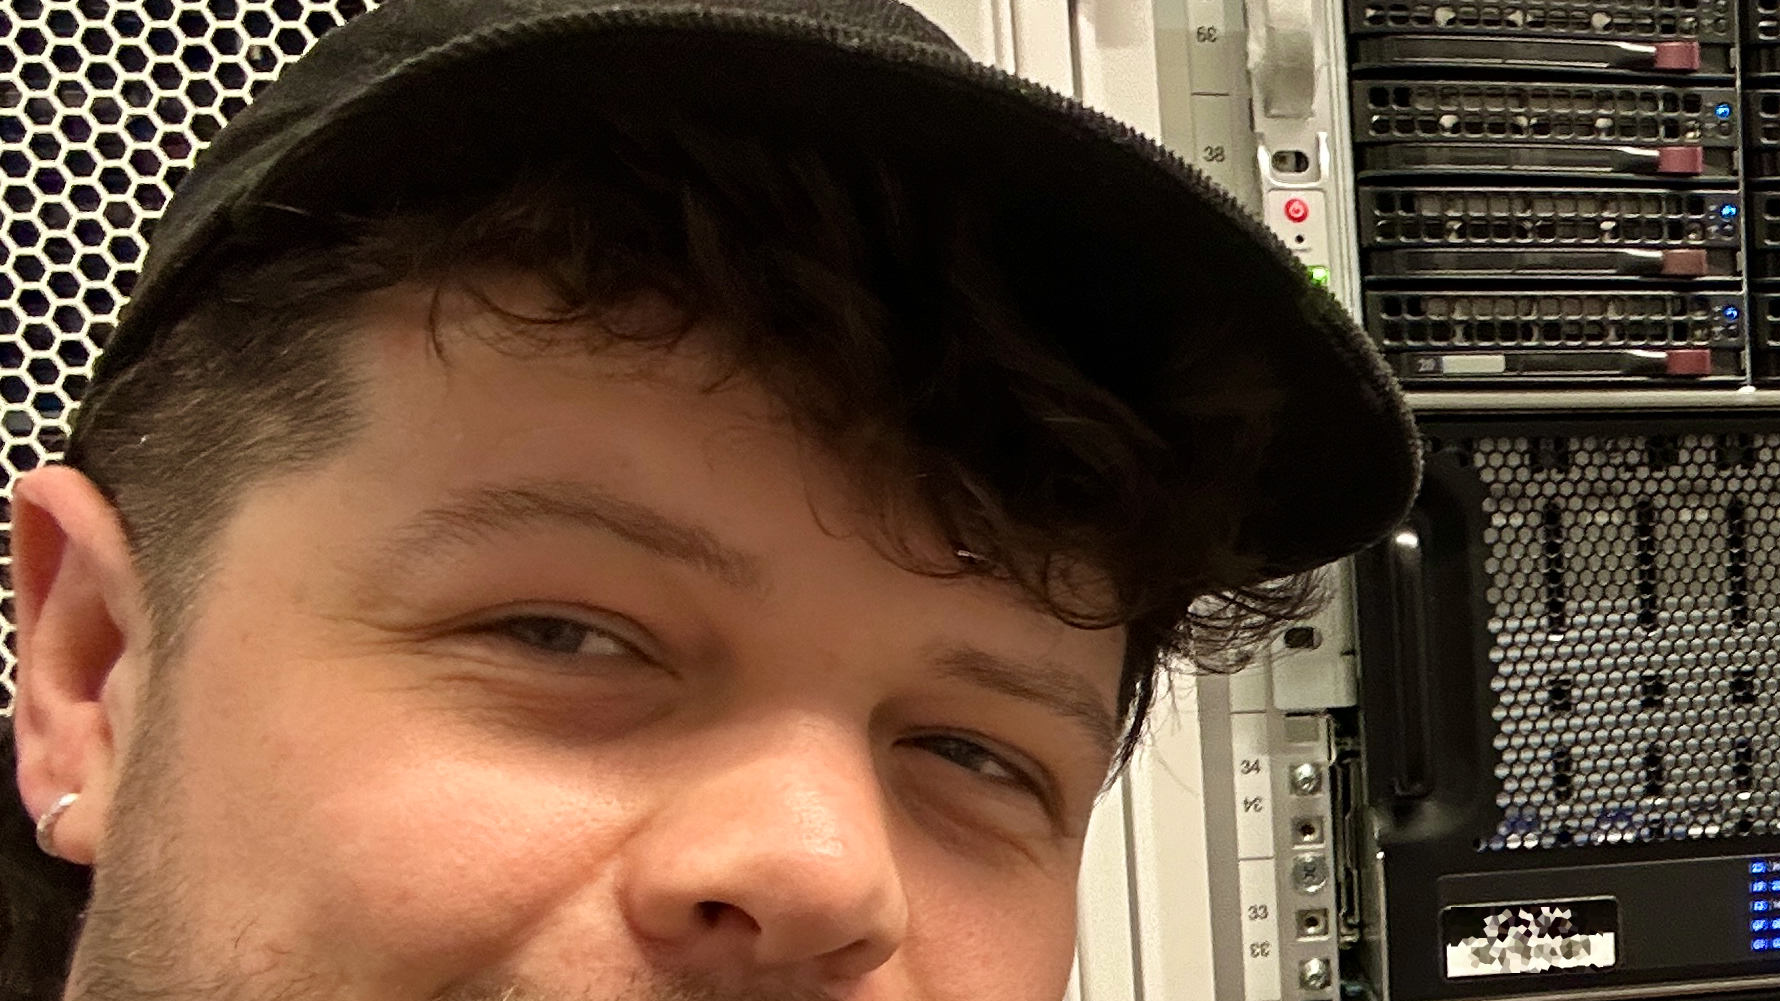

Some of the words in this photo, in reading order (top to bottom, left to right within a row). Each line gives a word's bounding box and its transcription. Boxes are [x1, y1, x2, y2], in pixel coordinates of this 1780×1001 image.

[1202, 145, 1226, 163] 38
[1240, 757, 1262, 775] 34
[1243, 795, 1263, 813] 34
[1248, 903, 1269, 921] 33
[1249, 941, 1271, 959] 33
